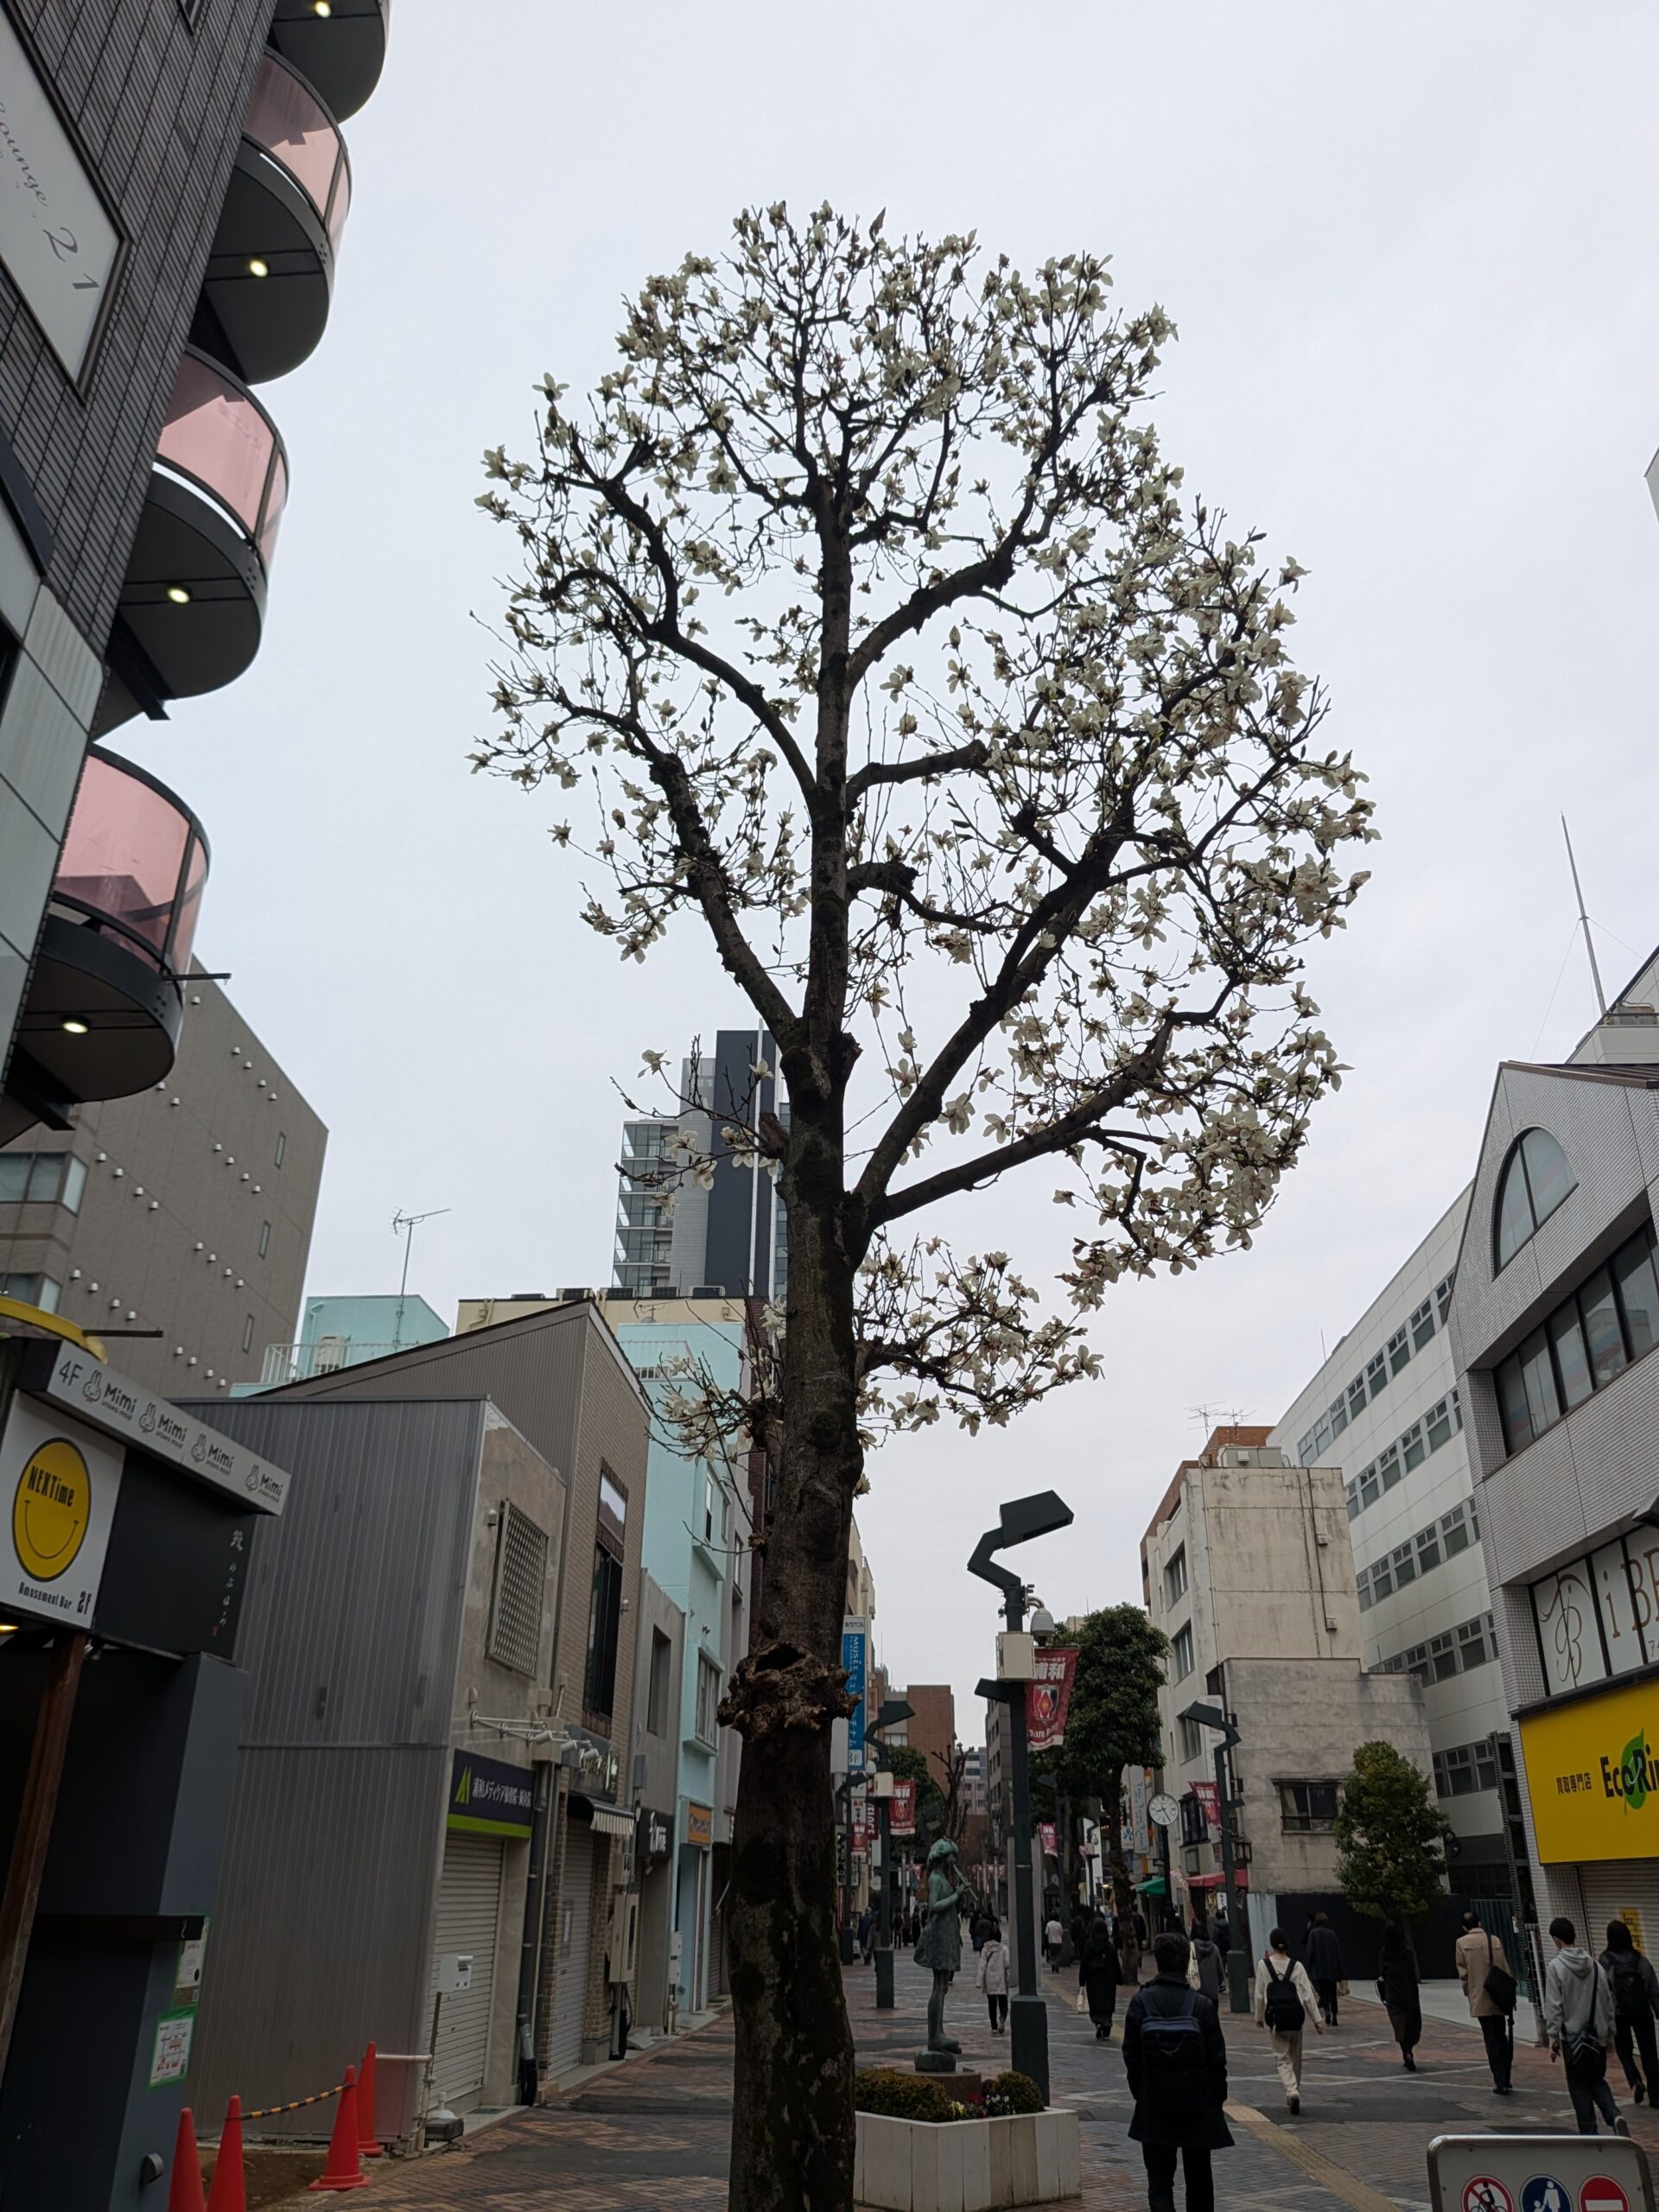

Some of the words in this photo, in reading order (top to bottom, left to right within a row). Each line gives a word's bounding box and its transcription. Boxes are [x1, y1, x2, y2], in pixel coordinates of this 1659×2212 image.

[59, 1360, 84, 1387] 4F
[104, 1382, 137, 1414] Mimi
[157, 1414, 188, 1442] Mimi
[207, 1444, 235, 1469] Mimi
[27, 1465, 75, 1508] NEXTime
[260, 1473, 283, 1497] Mimi
[18, 1580, 60, 1605] Amusement
[59, 1594, 73, 1610] Bar
[76, 1590, 92, 1615] 2F
[1555, 1771, 1592, 1796] 買取専門店
